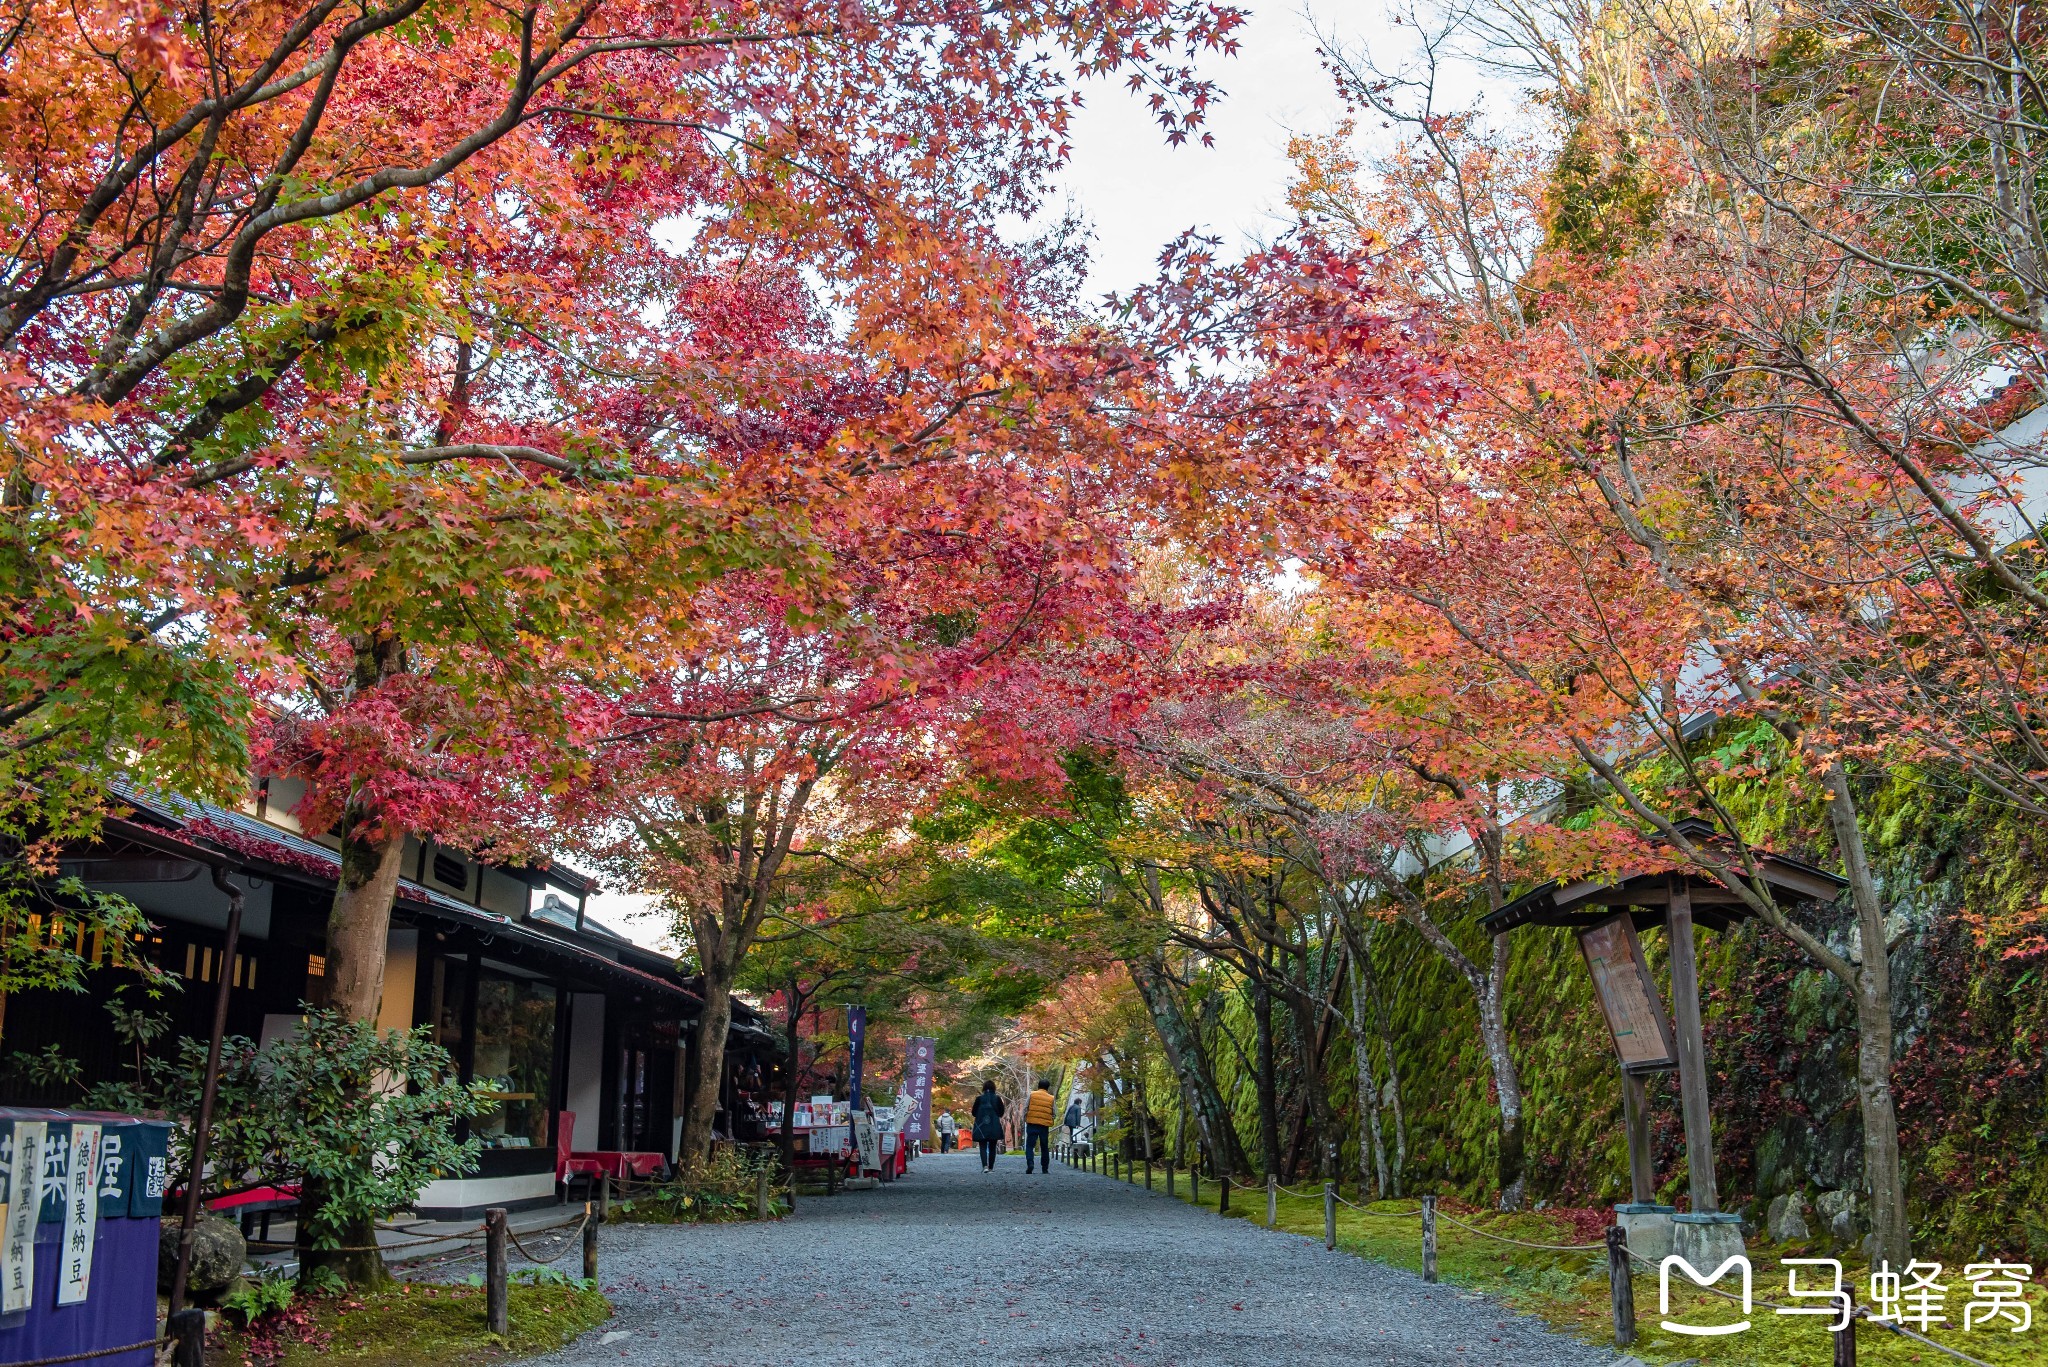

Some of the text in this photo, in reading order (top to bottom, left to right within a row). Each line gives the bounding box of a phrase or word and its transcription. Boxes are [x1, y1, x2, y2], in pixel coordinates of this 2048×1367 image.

[10, 1136, 36, 1291] 丹波黒豆納豆
[69, 1141, 90, 1285] 徳用栗納豆
